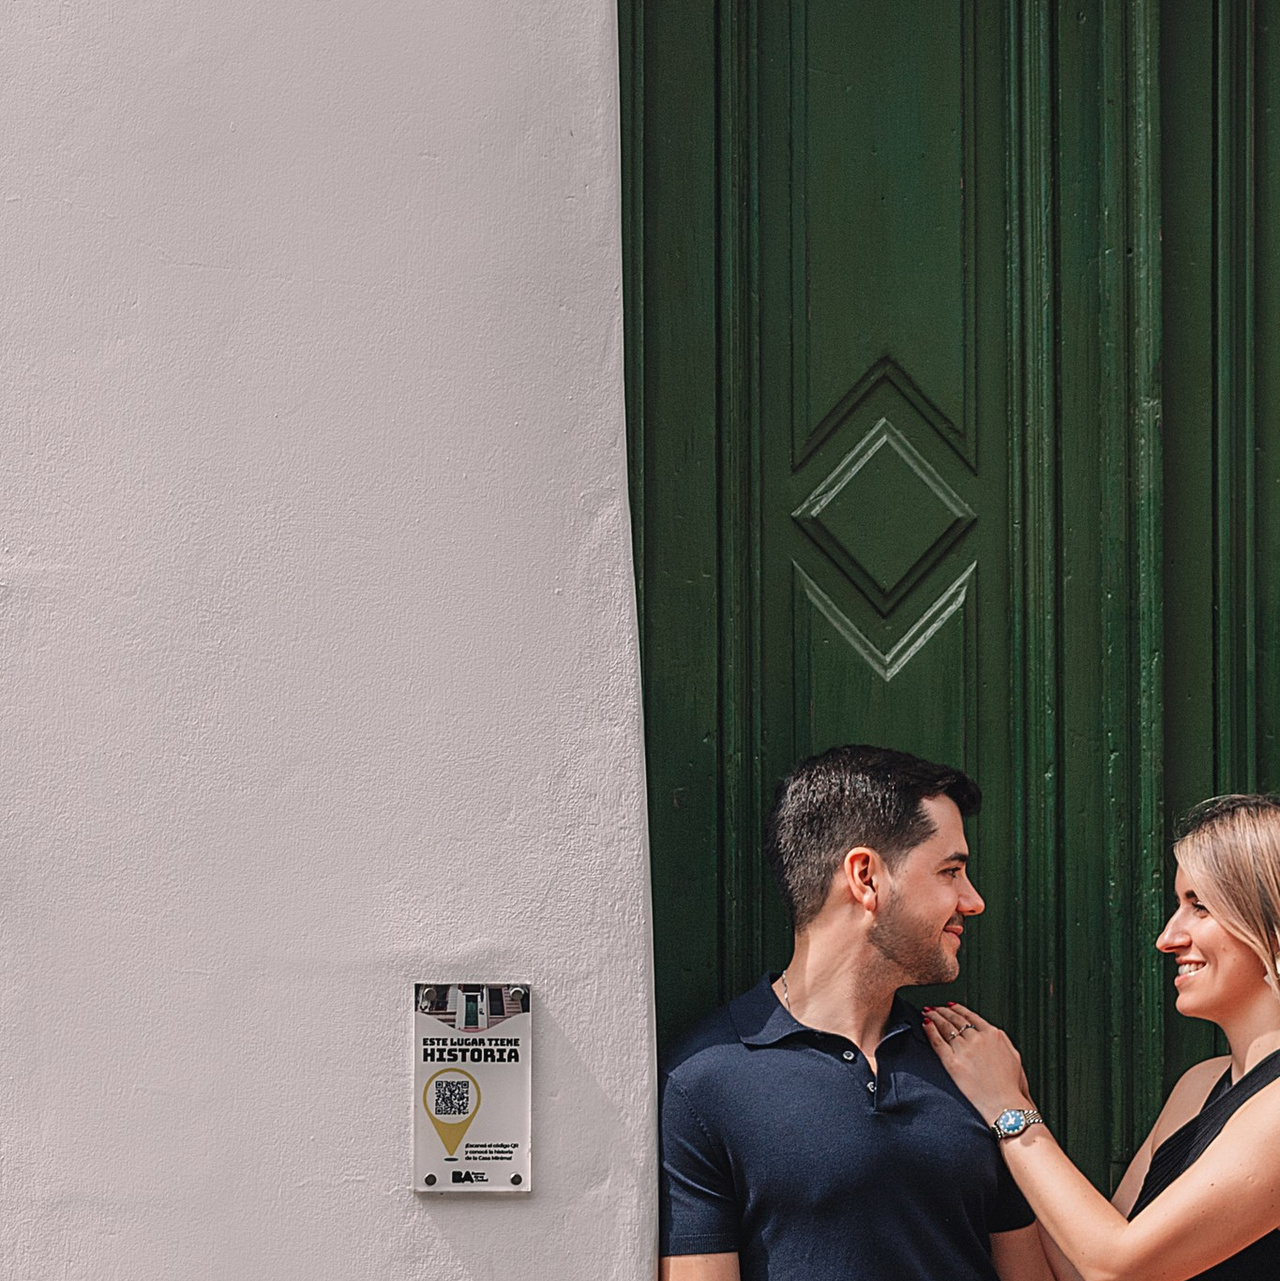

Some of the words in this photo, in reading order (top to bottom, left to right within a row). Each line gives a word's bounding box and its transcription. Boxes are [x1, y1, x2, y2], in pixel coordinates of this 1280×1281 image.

[423, 1038, 448, 1046] ESTE
[450, 1038, 485, 1046] LUGAR
[487, 1038, 519, 1046] TIENE
[423, 1048, 519, 1062] HISTORIA
